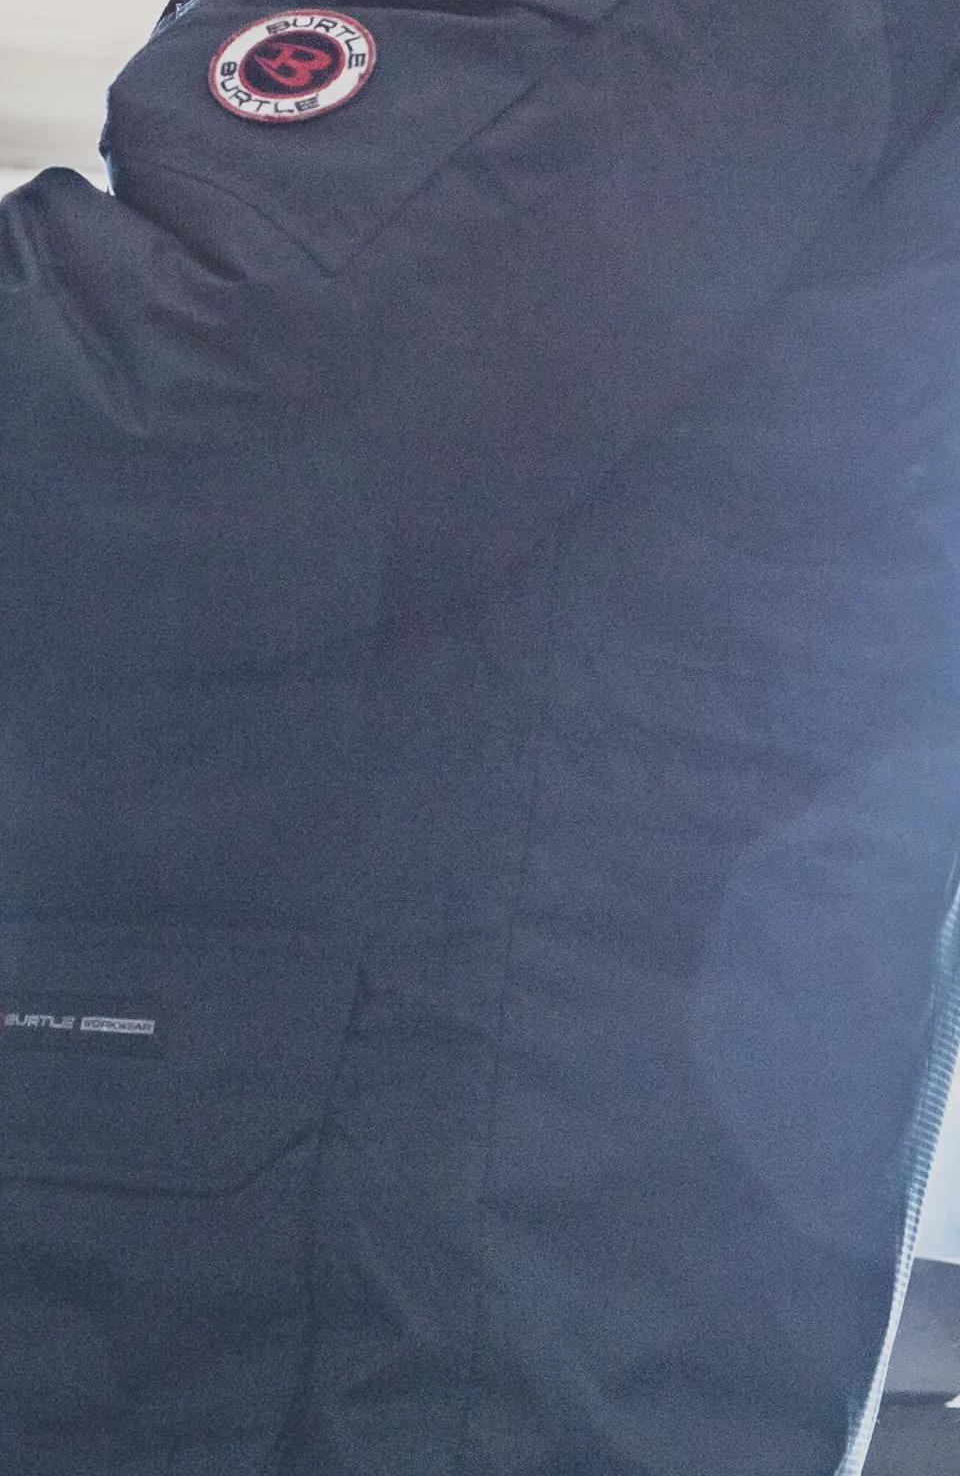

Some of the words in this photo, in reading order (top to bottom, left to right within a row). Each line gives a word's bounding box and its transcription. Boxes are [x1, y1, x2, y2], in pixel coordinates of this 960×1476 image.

[266, 17, 366, 69] BURTLE
[221, 61, 320, 113] BURTLE
[4, 1014, 75, 1029] BURTLE
